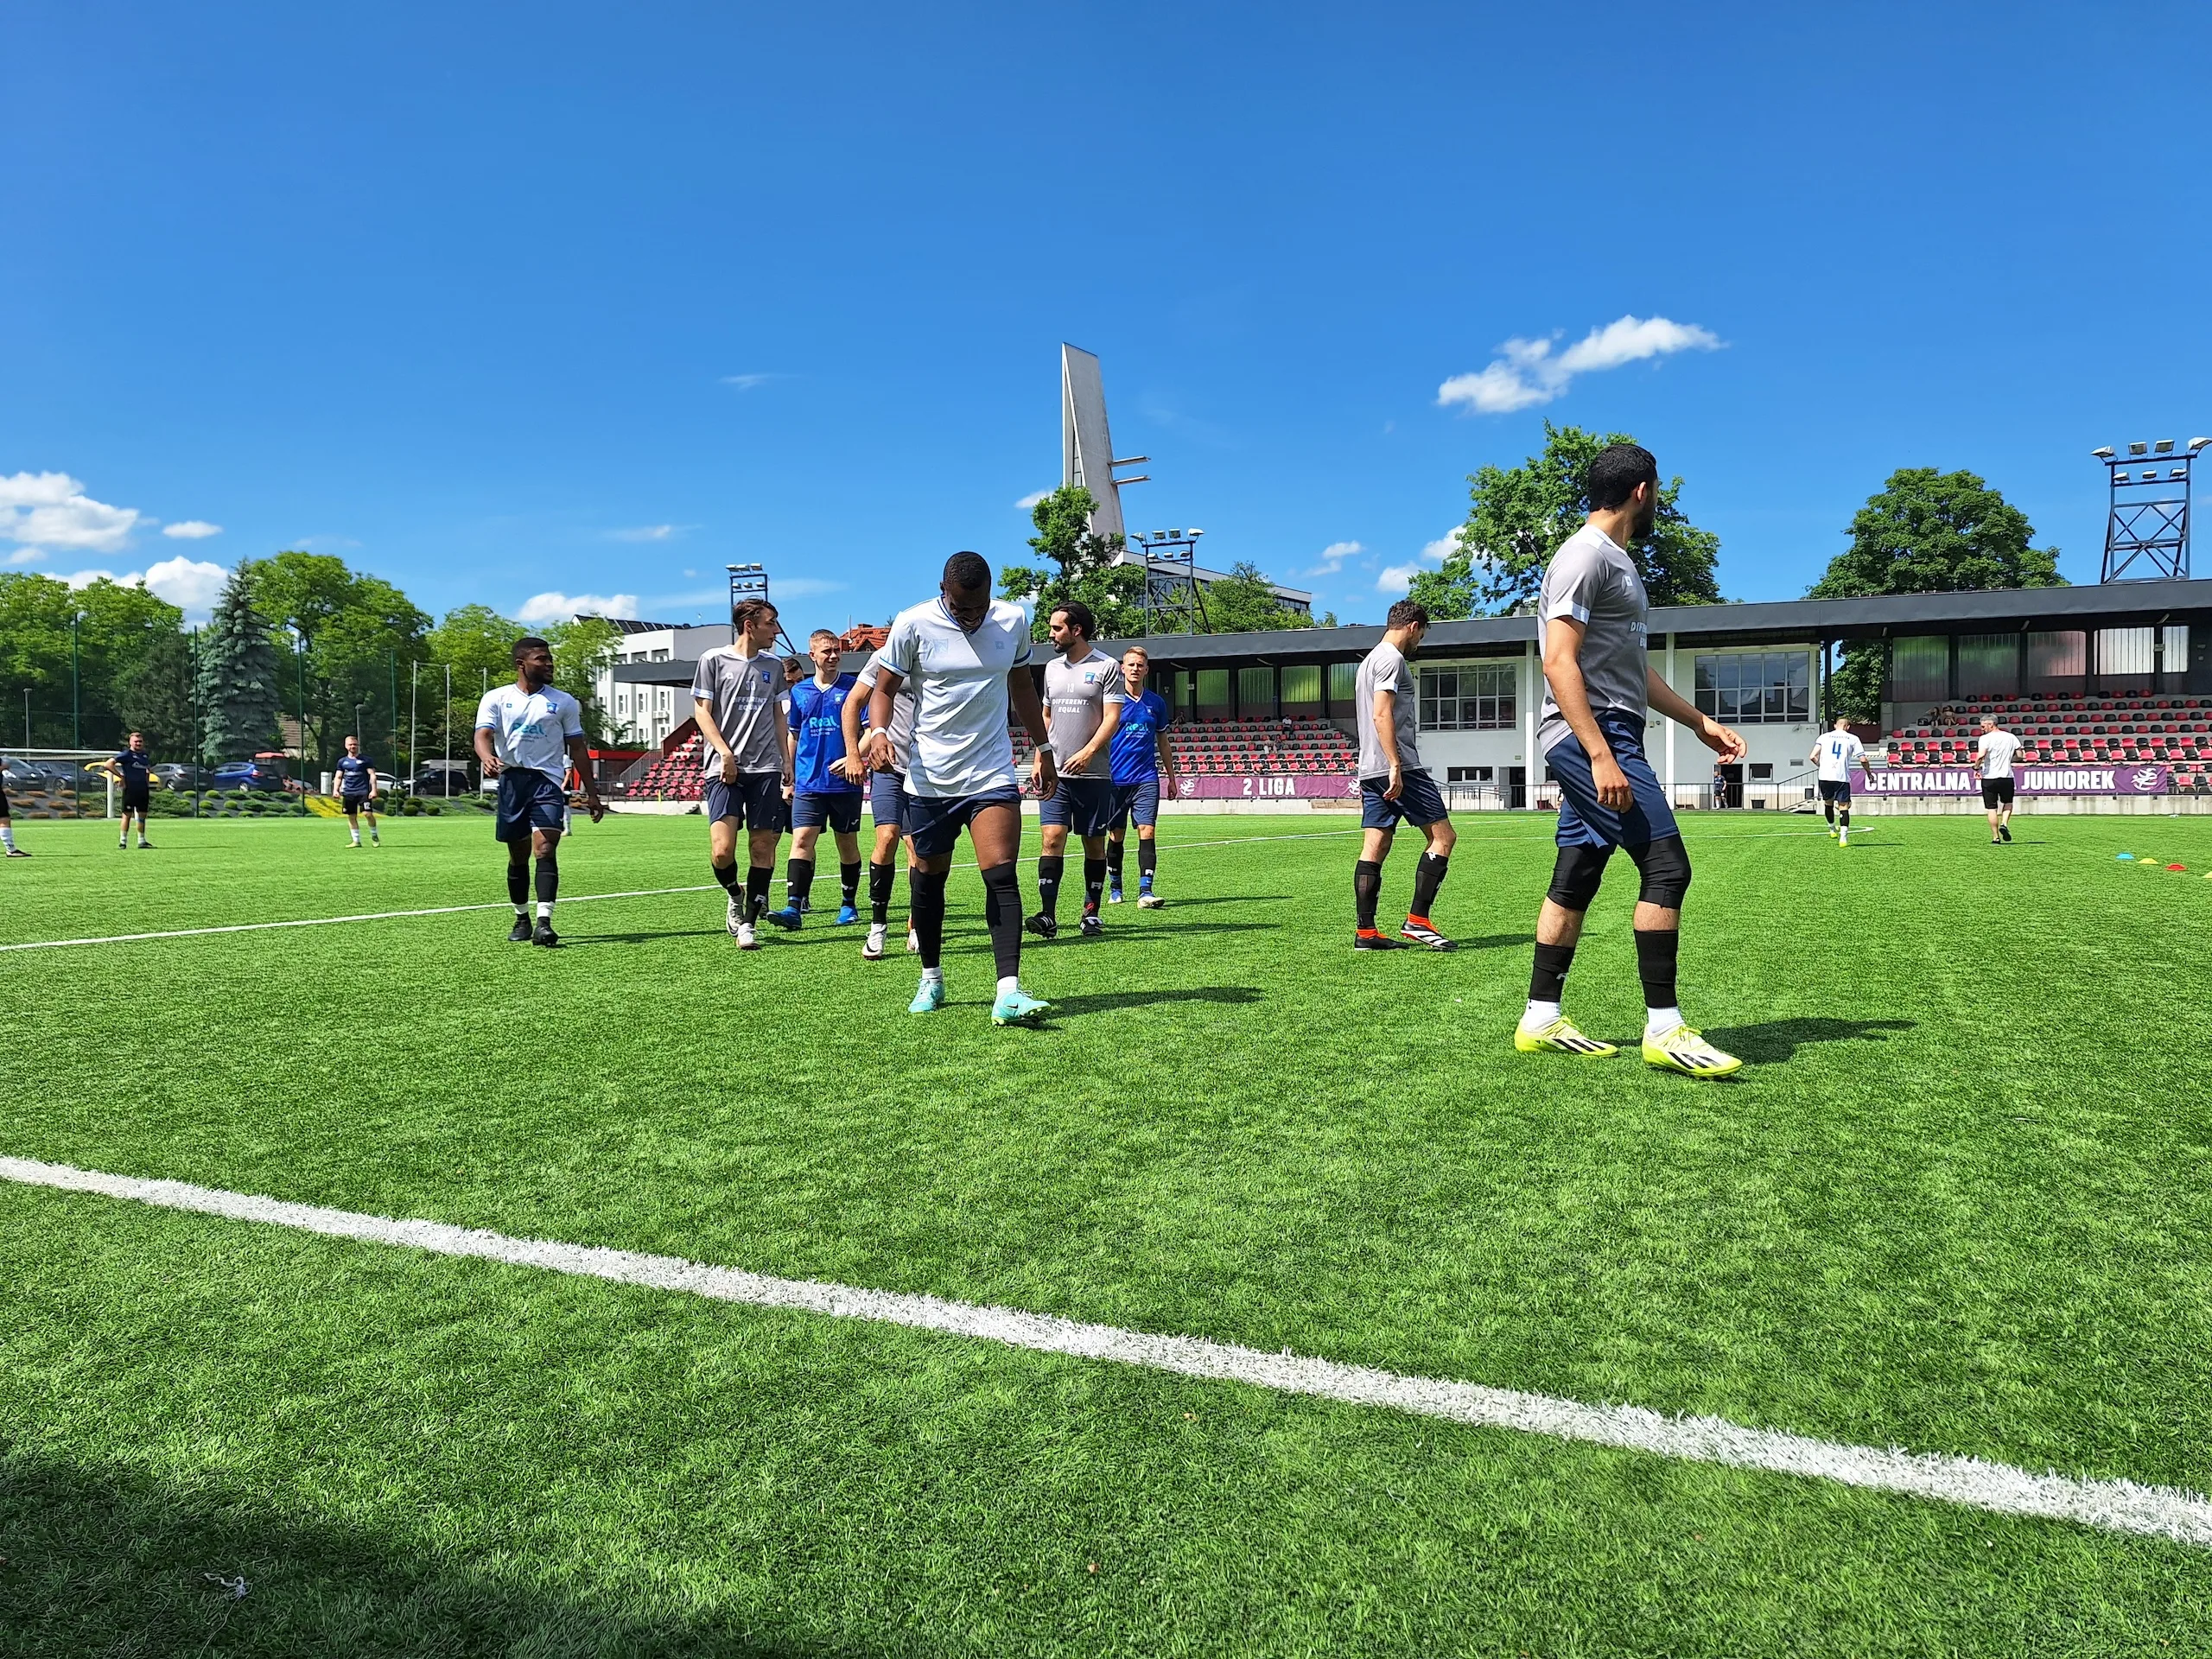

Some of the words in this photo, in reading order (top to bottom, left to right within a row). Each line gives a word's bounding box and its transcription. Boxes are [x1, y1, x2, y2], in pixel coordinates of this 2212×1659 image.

[1832, 741, 1842, 760] 4
[1243, 778, 1252, 796] 2
[1258, 778, 1296, 796] LIGA
[1864, 772, 1972, 791] CENTRALNA
[2021, 770, 2116, 791] JUNIOREK
